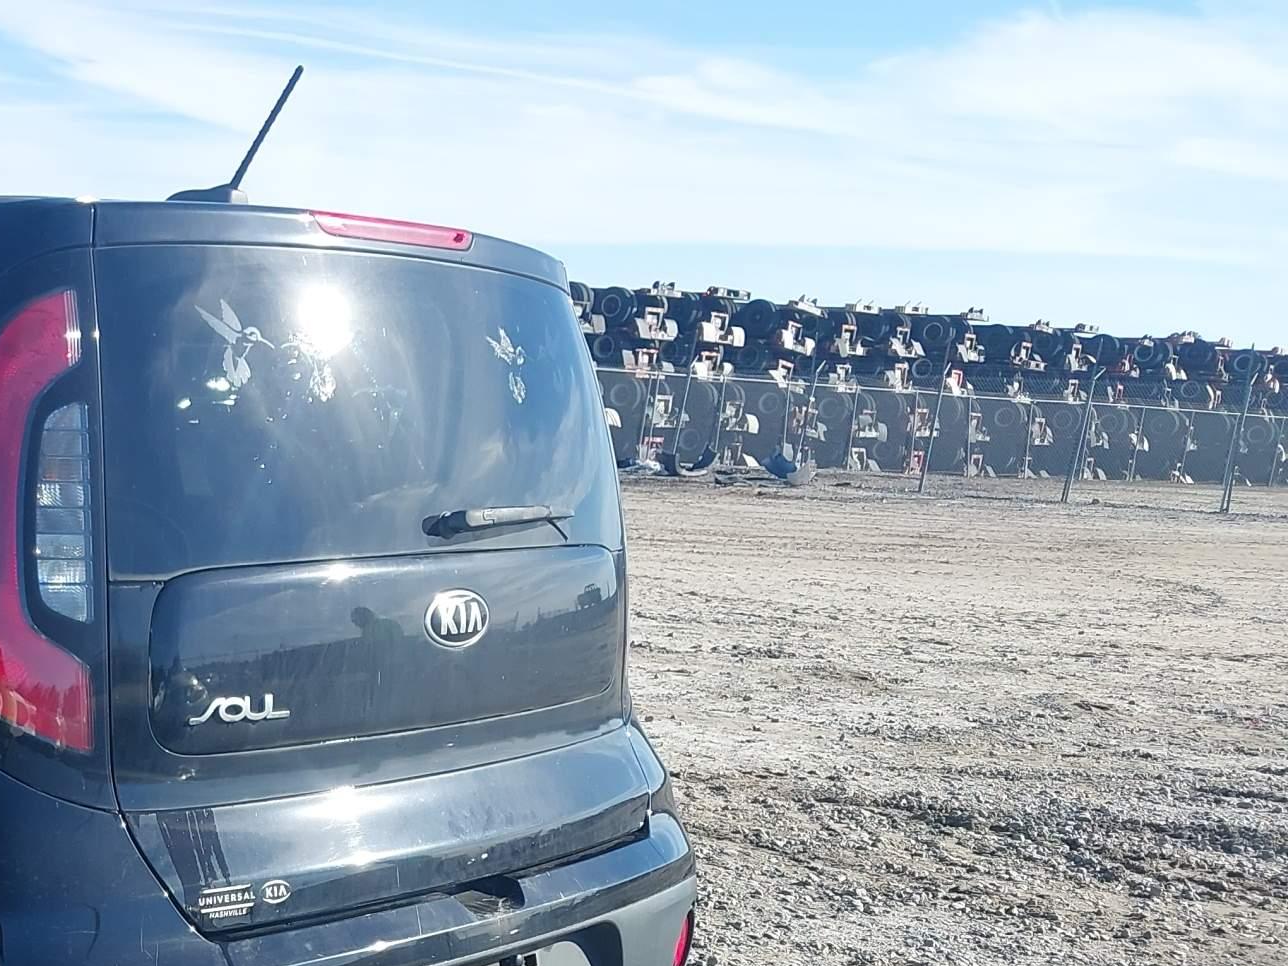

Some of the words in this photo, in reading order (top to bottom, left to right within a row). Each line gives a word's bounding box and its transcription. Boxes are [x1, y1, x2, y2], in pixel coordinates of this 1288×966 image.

[438, 601, 483, 635] KIA
[189, 693, 290, 725] SOUL
[198, 891, 256, 906] UNIVERSAL
[265, 885, 287, 899] KIA
[209, 908, 248, 919] NASHVILLE
